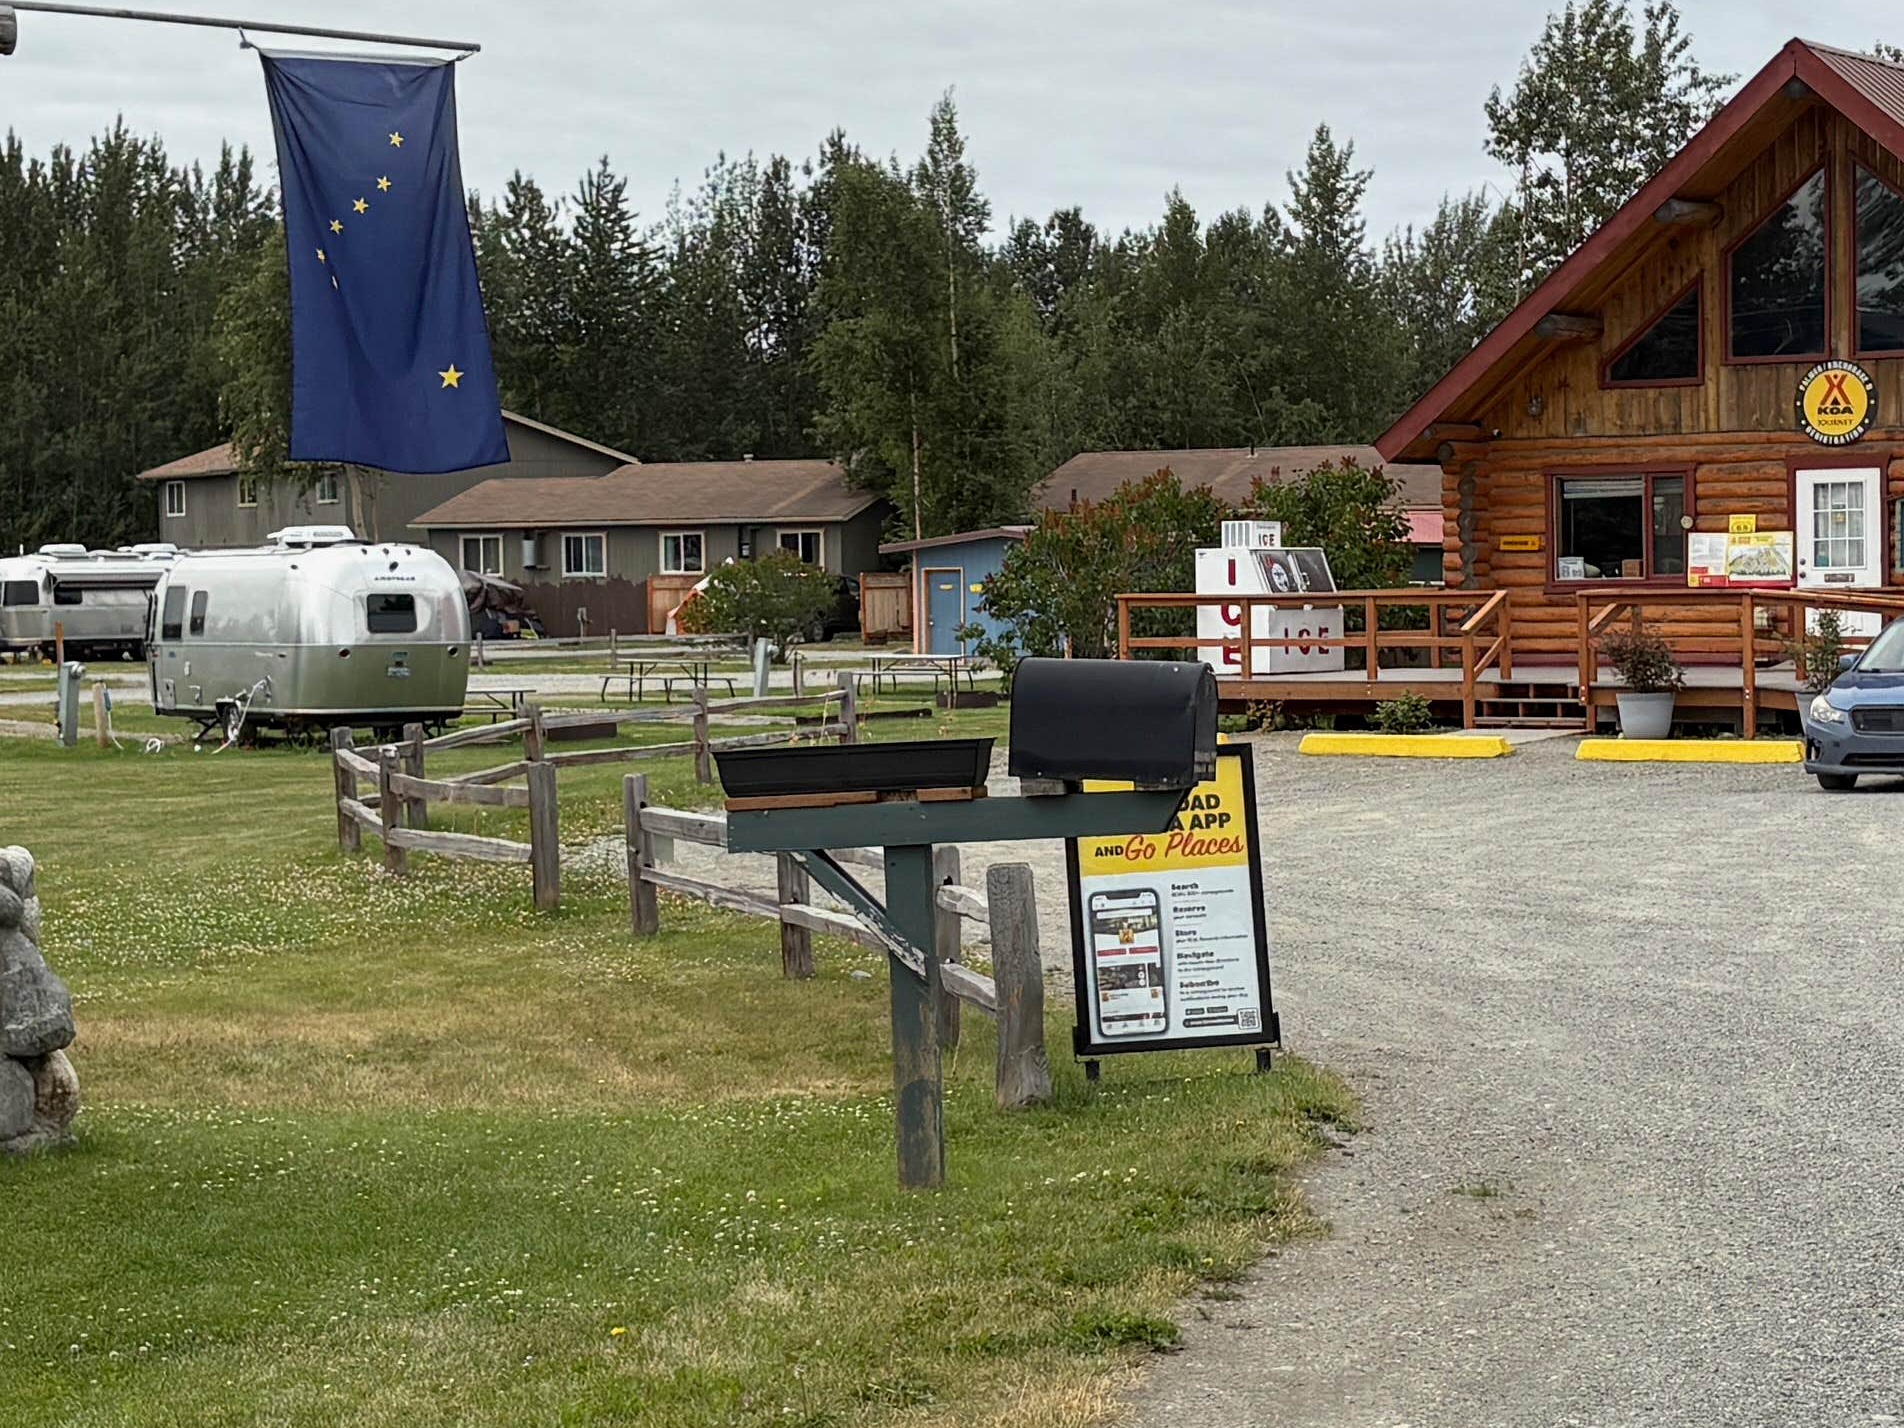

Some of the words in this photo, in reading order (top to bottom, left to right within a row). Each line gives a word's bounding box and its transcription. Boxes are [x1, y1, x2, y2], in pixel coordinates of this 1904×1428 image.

[1817, 406, 1854, 415] KOA
[1258, 533, 1275, 547] ICE
[1284, 627, 1330, 655] ICE
[1189, 812, 1232, 830] APP
[1094, 845, 1123, 857] AND
[1125, 834, 1156, 861] Go
[1165, 831, 1244, 858] Places
